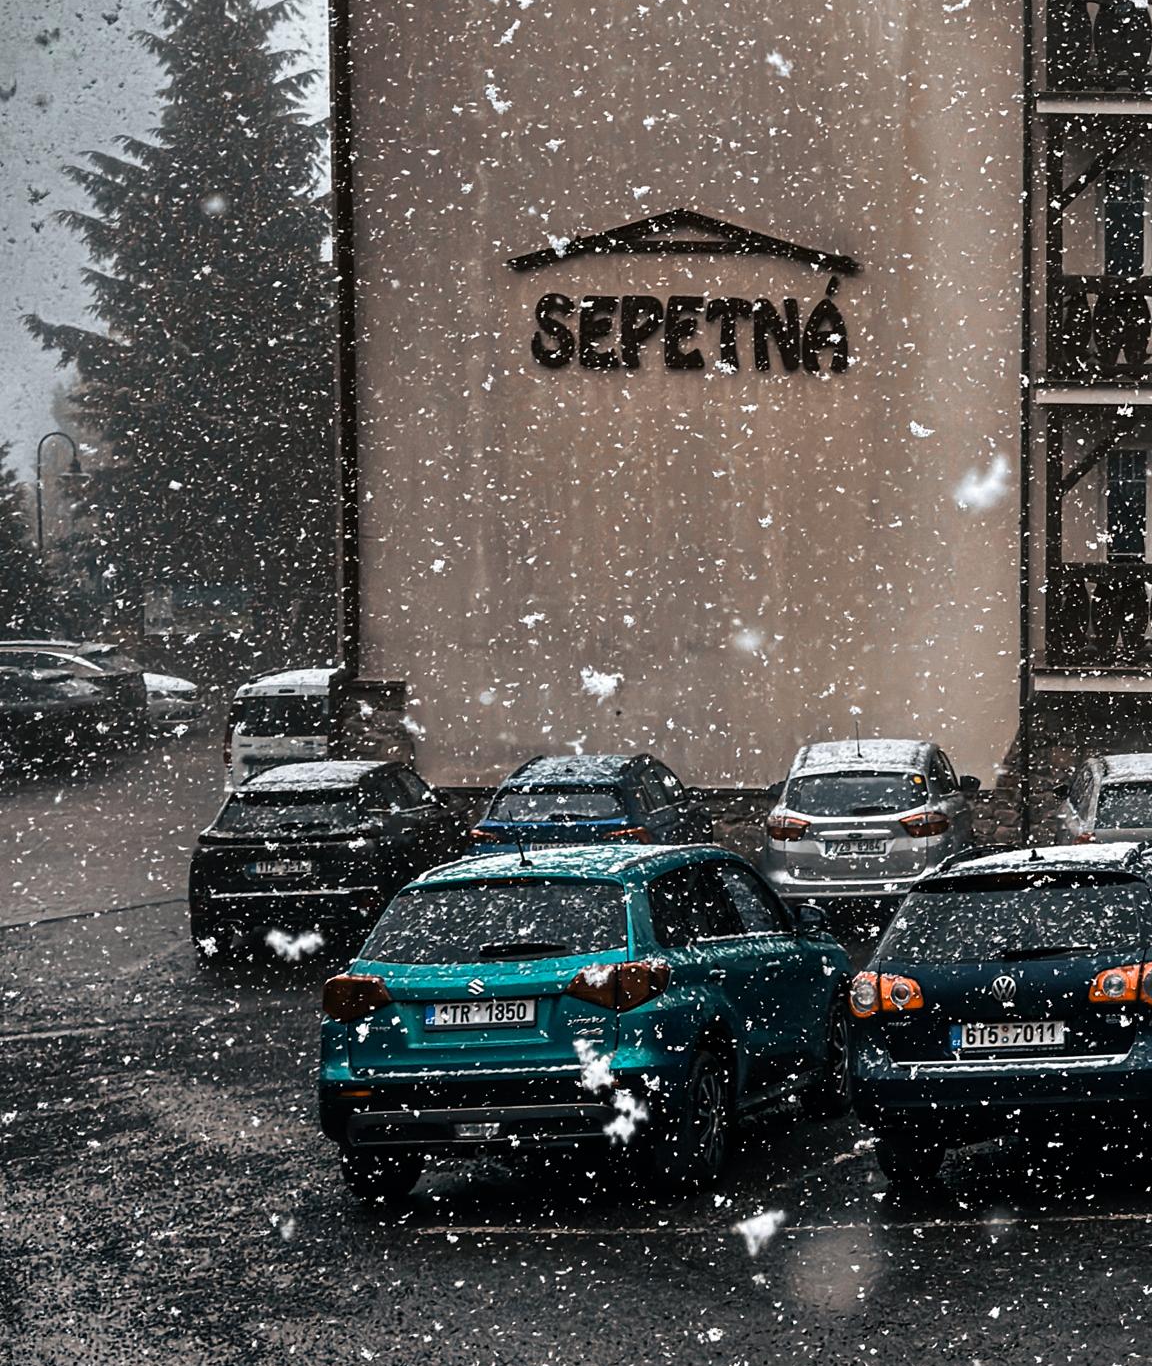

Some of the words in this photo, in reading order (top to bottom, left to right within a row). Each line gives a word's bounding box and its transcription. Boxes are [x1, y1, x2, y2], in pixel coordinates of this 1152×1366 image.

[531, 276, 849, 374] SEPETNÁ
[439, 1004, 471, 1024] 1TR
[485, 1002, 527, 1022] 1850
[965, 1024, 999, 1045] 6T5
[1012, 1023, 1056, 1044] 7011
